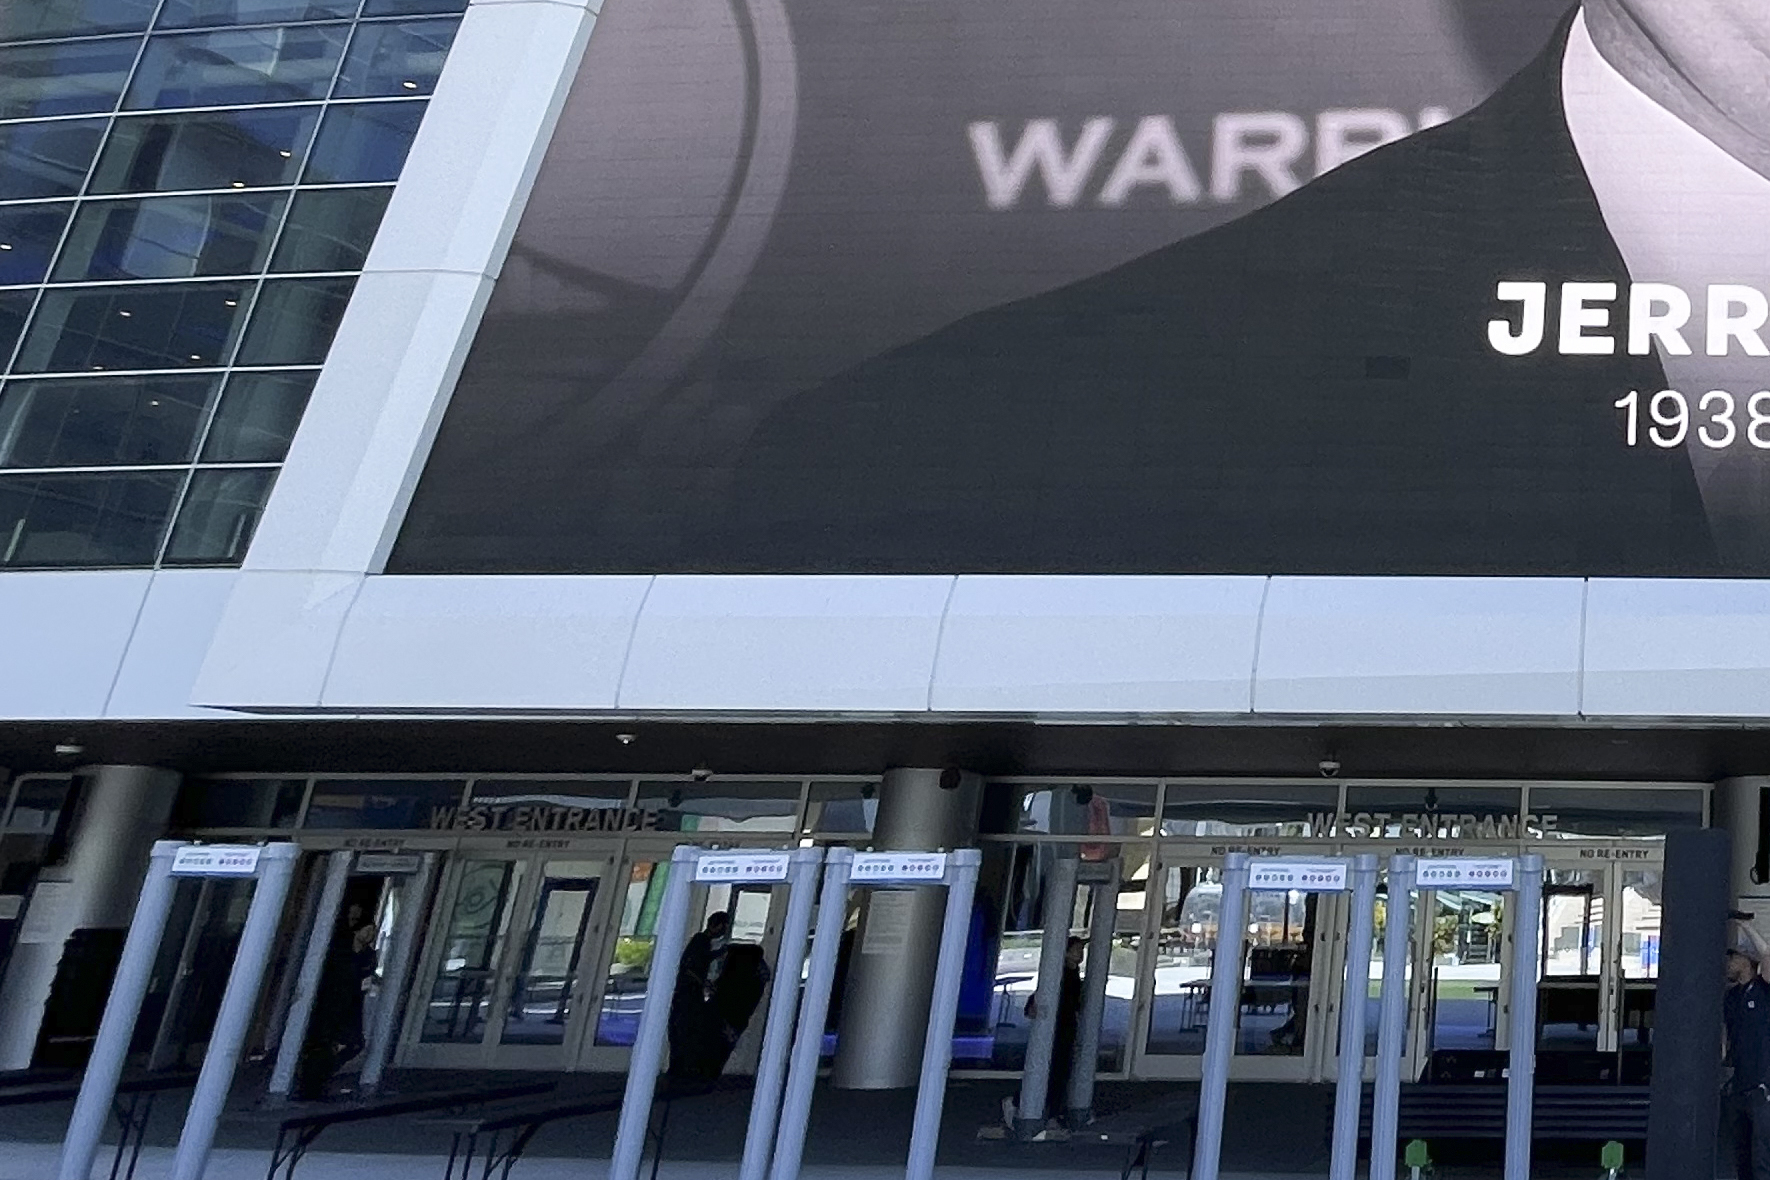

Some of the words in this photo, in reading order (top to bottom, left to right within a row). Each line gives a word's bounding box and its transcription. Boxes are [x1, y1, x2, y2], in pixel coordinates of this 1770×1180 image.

[430, 806, 507, 831] WEST
[515, 807, 660, 832] ENTRANCE
[1307, 812, 1393, 838] WEST
[1400, 812, 1559, 839] ENTRANCE
[1579, 849, 1595, 859] NO
[1597, 849, 1649, 859] RE-ENTRY
